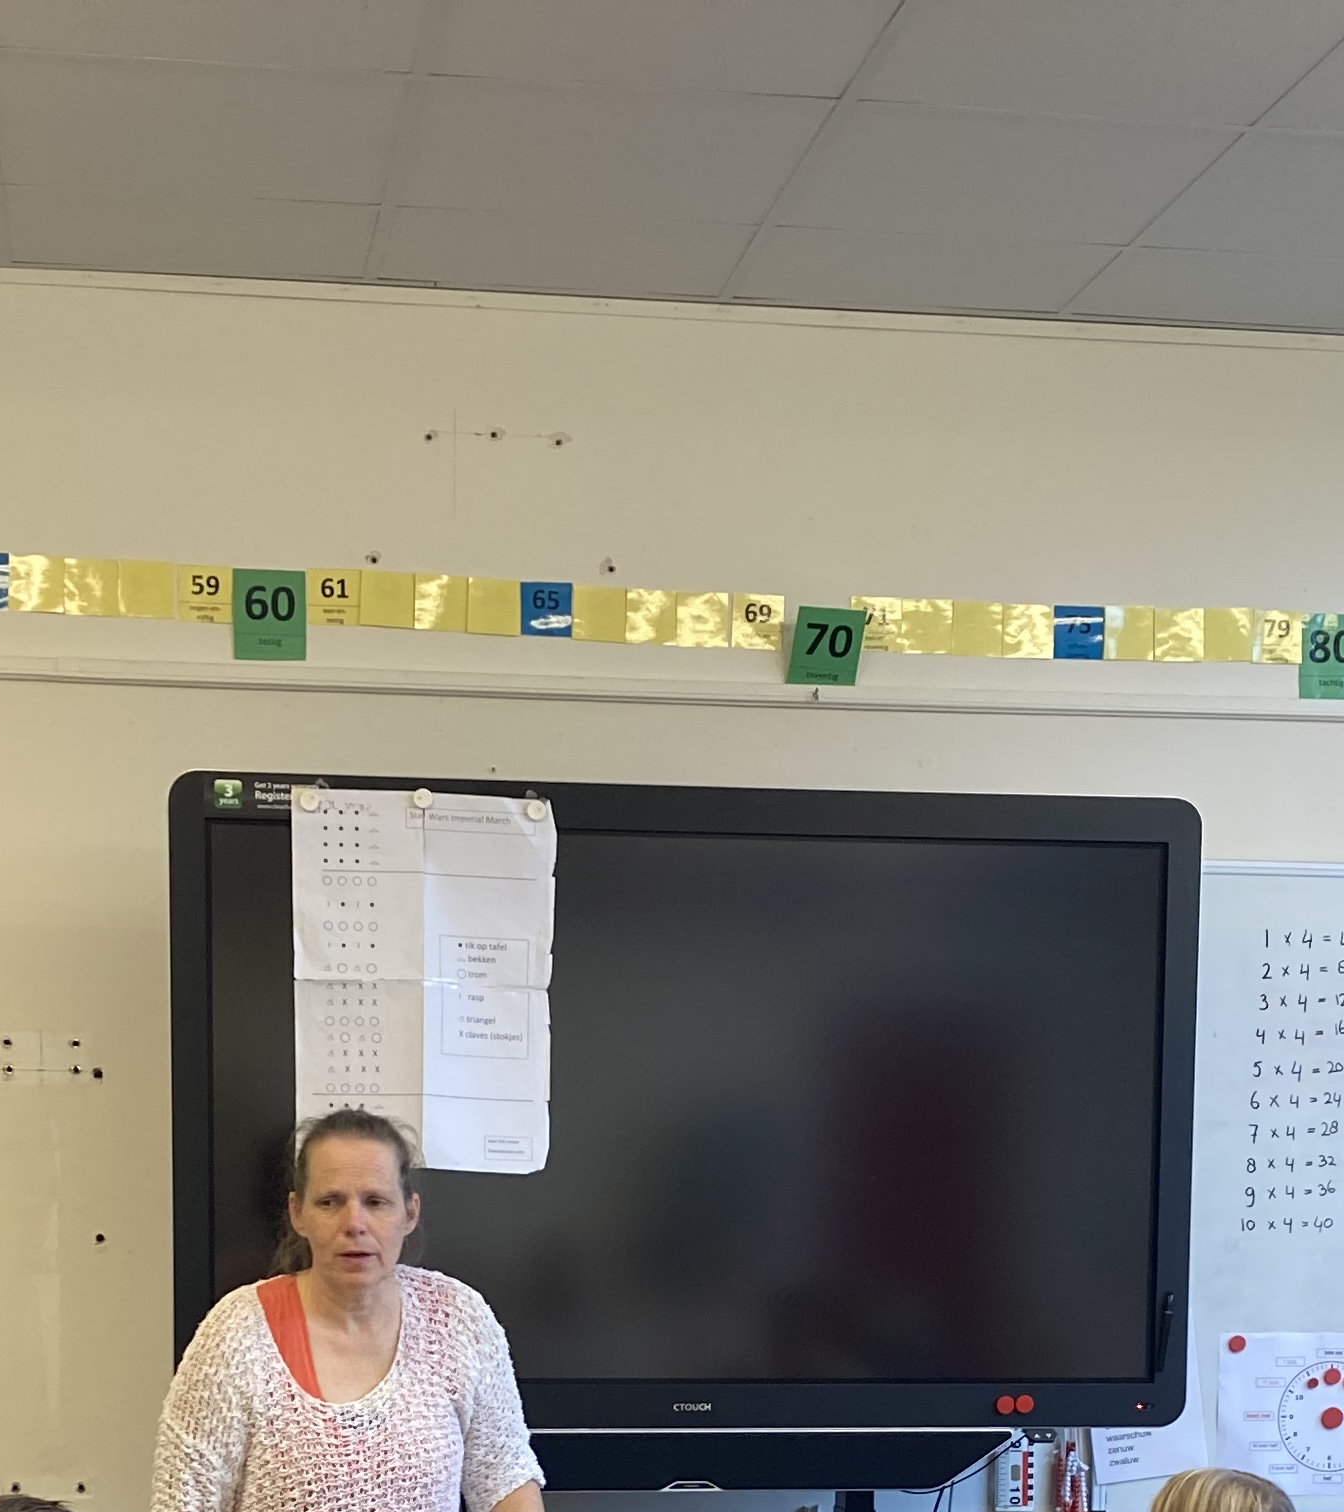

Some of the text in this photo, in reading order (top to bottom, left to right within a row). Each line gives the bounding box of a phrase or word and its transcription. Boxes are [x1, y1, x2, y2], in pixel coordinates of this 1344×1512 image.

[192, 575, 219, 595] 59
[321, 578, 349, 598] 61
[245, 586, 295, 621] 60
[533, 589, 559, 610] 65
[745, 602, 773, 623] 69
[1264, 619, 1290, 639] 79
[806, 623, 852, 658] 70
[223, 784, 234, 798] 3
[1302, 929, 1312, 949] 4
[1261, 962, 1273, 980] 2
[1299, 963, 1310, 981] 4
[1258, 994, 1270, 1011] 3
[1298, 994, 1307, 1012] 4
[1256, 1029, 1265, 1044] 4
[1294, 1029, 1305, 1046] 4
[1253, 1061, 1262, 1077] 5
[1291, 1061, 1302, 1082] 4
[1327, 1061, 1343, 1074] 20
[1249, 1090, 1260, 1110] 6
[1289, 1094, 1300, 1109] 4
[1324, 1092, 1341, 1107] 24
[1248, 1123, 1259, 1145] 7
[1285, 1125, 1296, 1141] 4
[1321, 1121, 1338, 1136] 28
[1246, 1157, 1257, 1174] 8
[1285, 1156, 1295, 1173] 4
[1319, 1155, 1336, 1167] 32
[1245, 1187, 1255, 1207] 9
[1285, 1185, 1295, 1200] 4
[1318, 1181, 1335, 1196] 36
[1240, 1218, 1256, 1232] 10
[1282, 1217, 1293, 1234] 4
[1314, 1217, 1333, 1233] 40
[673, 1403, 711, 1411] CTOUCH
